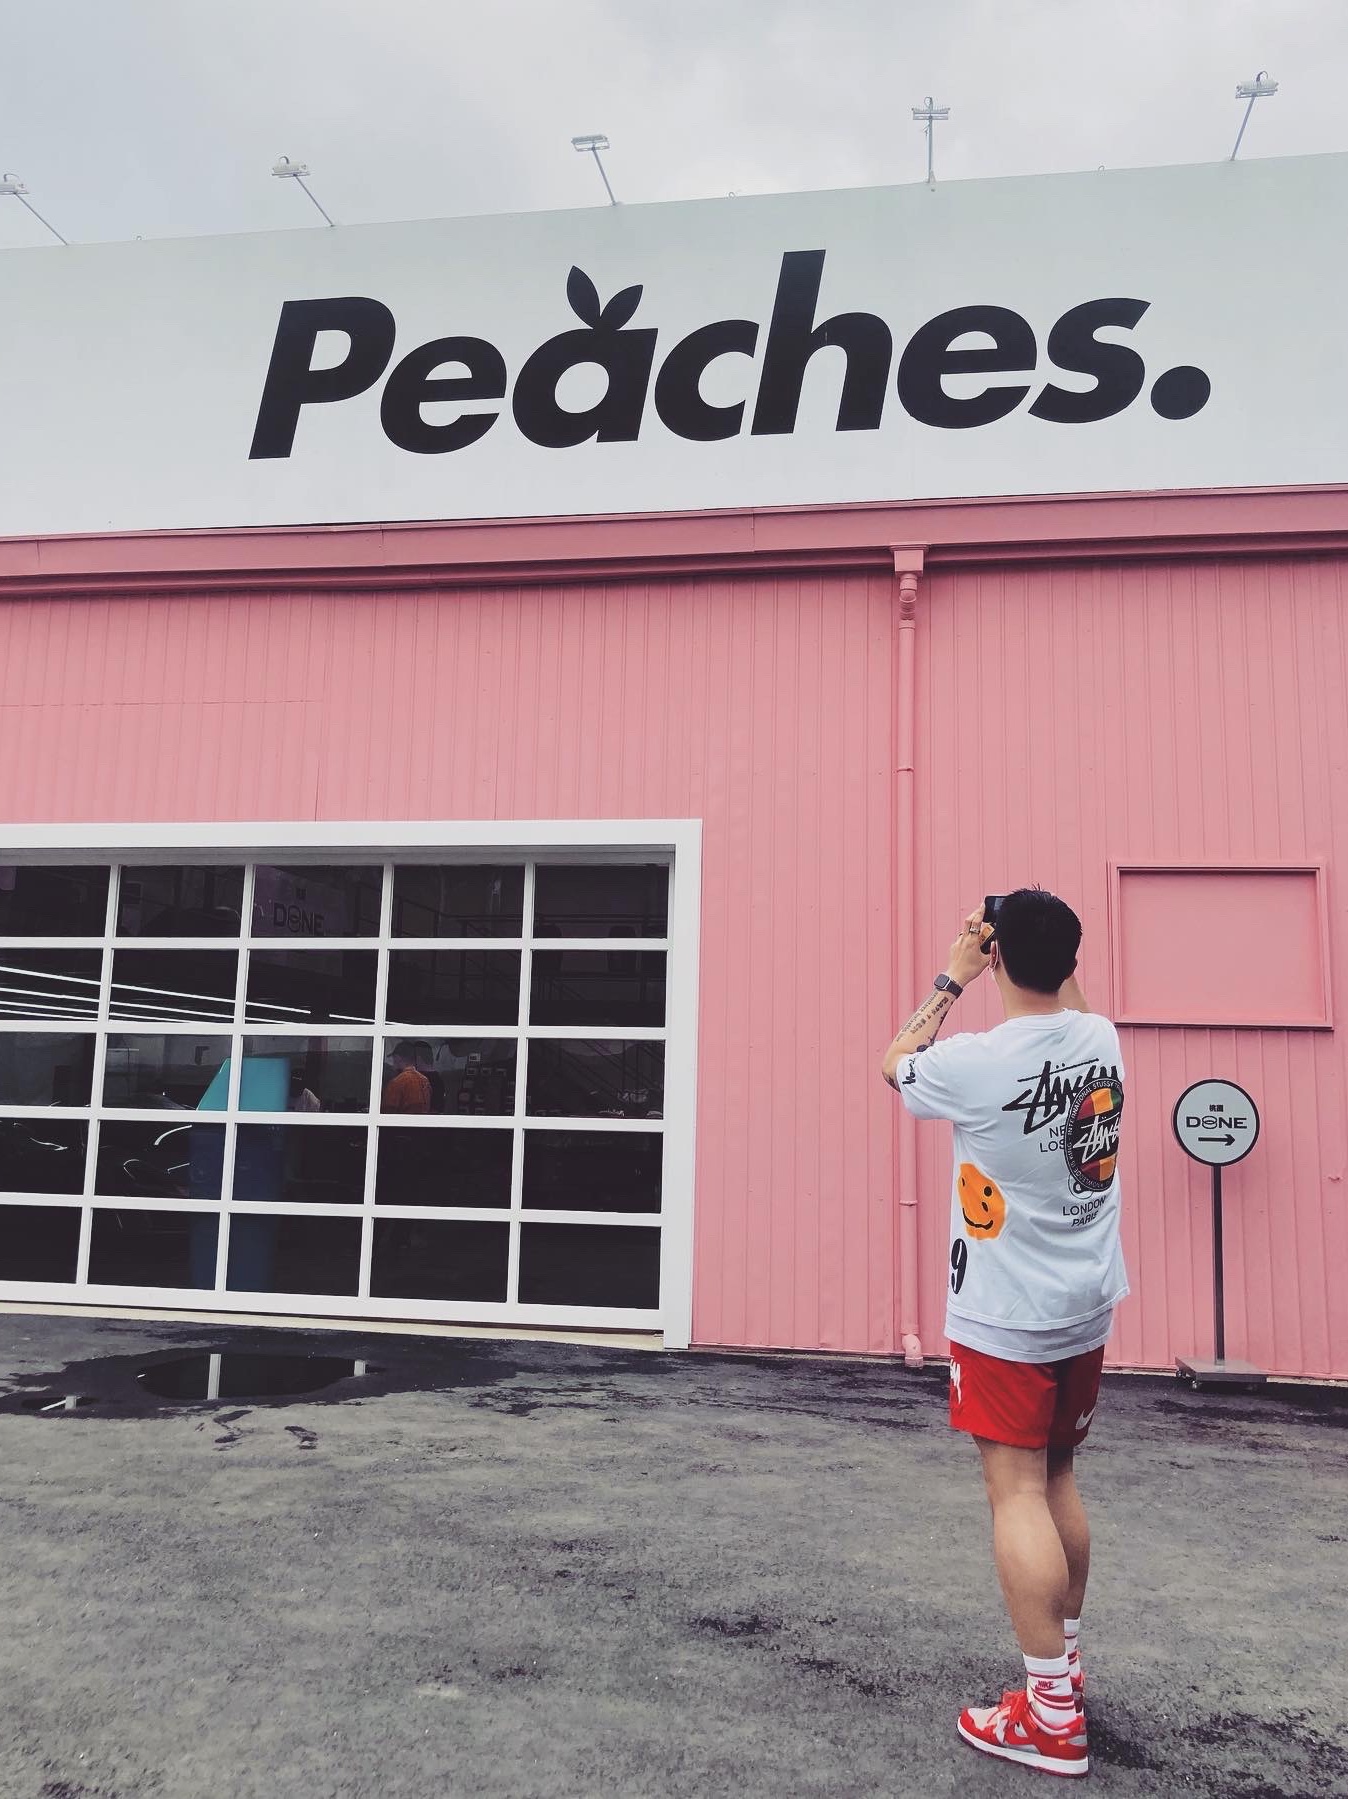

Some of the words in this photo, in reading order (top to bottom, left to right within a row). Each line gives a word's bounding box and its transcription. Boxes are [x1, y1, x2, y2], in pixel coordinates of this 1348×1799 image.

[249, 250, 1210, 459] Peaches.
[273, 902, 325, 936] DONE
[1185, 1115, 1248, 1130] DONE
[1049, 1124, 1066, 1140] NE
[1062, 1195, 1107, 1216] LONDON
[1071, 1210, 1099, 1227] PARIS
[1038, 1680, 1053, 1688] NIKE
